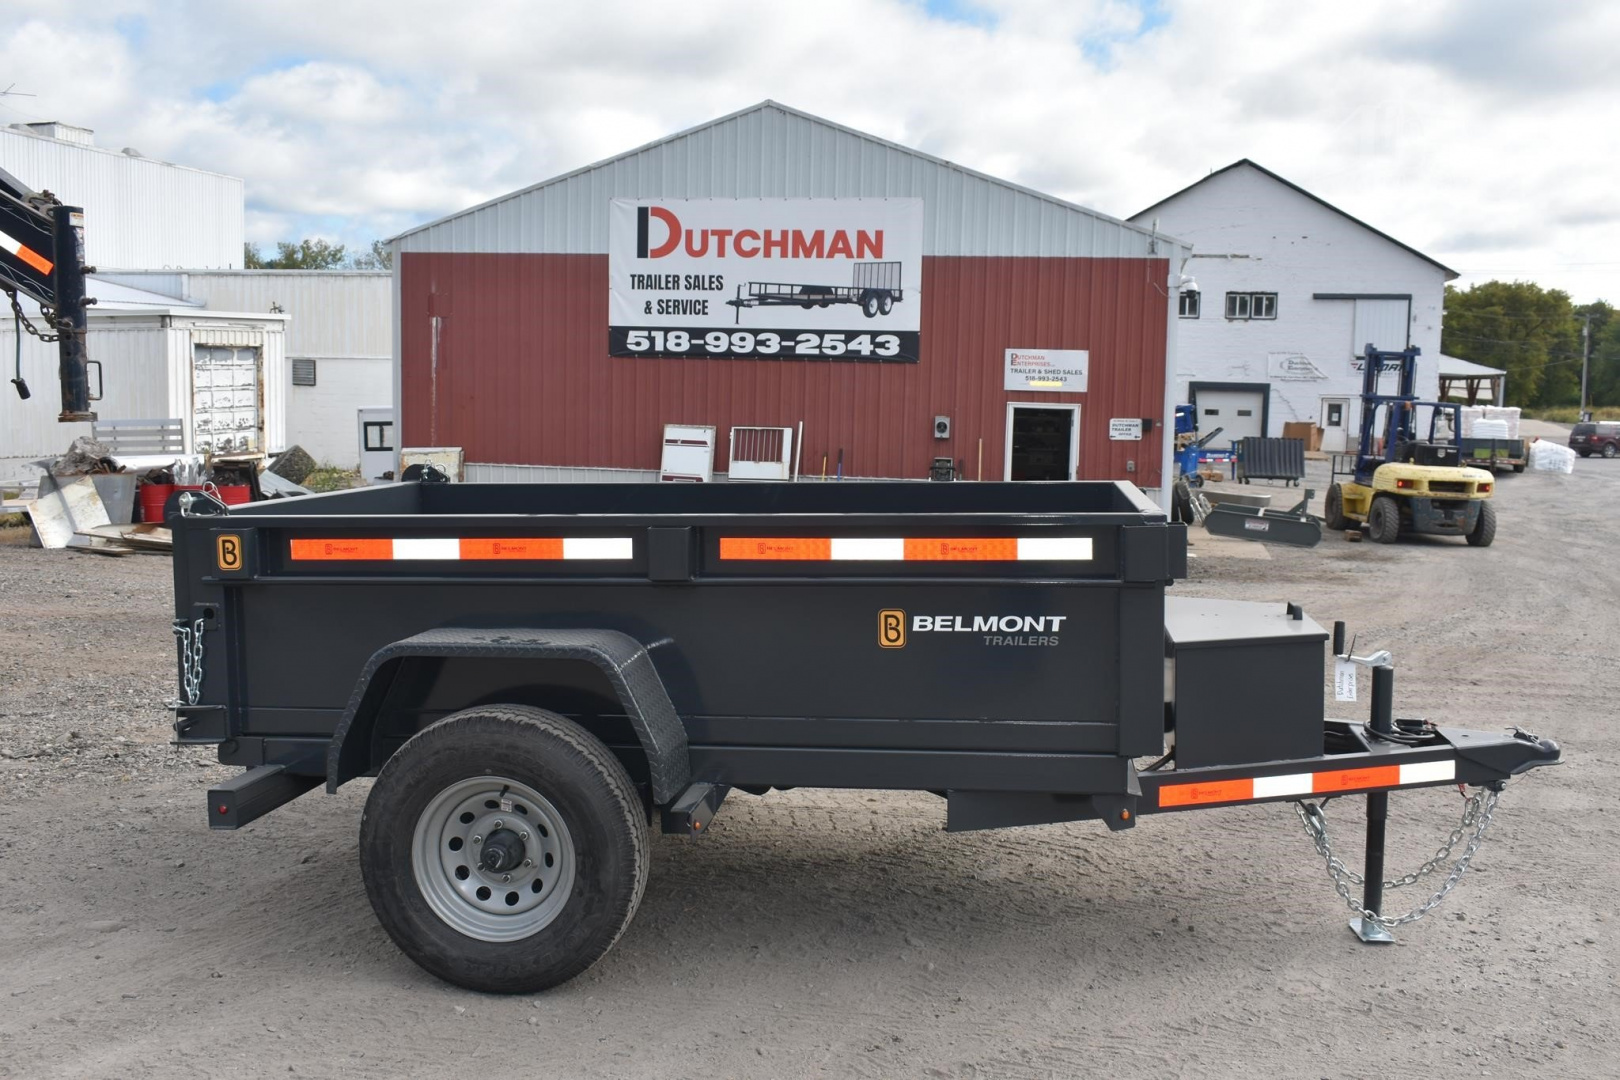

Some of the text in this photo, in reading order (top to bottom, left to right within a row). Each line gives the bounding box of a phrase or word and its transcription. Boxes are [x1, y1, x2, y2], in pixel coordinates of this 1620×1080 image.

[637, 206, 884, 259] DUTCHMAN
[630, 274, 724, 291] TRAILER SALES
[644, 299, 709, 315] & SERVICE
[626, 330, 900, 356] 518-993-2543
[912, 615, 1067, 632] BELMONT
[983, 635, 1059, 646] TRAILERS
